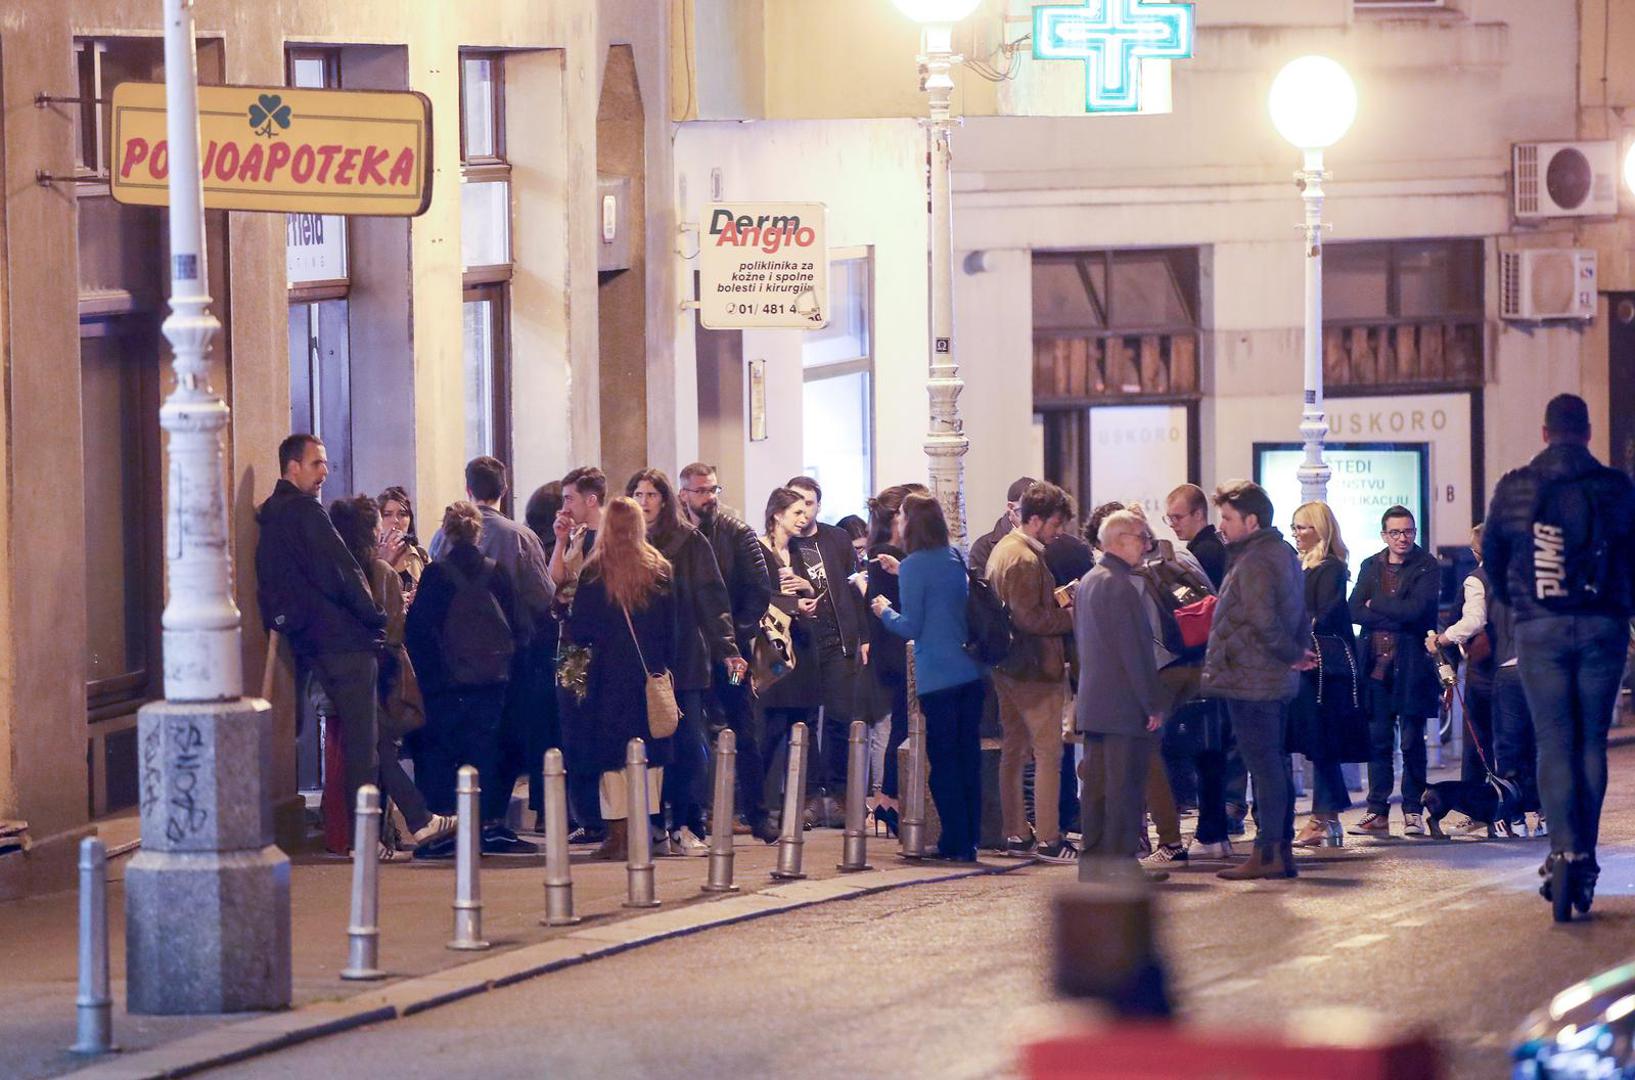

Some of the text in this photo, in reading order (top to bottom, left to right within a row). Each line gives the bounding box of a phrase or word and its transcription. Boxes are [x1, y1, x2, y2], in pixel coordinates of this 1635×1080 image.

[120, 137, 415, 186] POJOAPOTEKA
[709, 209, 801, 235] Derm
[715, 220, 816, 255] Angio
[732, 272, 766, 281] kožne
[775, 272, 814, 283] spolne
[739, 261, 814, 272] poliklinika za
[717, 283, 756, 293] bolesti
[762, 304, 784, 314] 481
[1329, 409, 1447, 435] USKORO
[1533, 522, 1569, 600] PUMA
